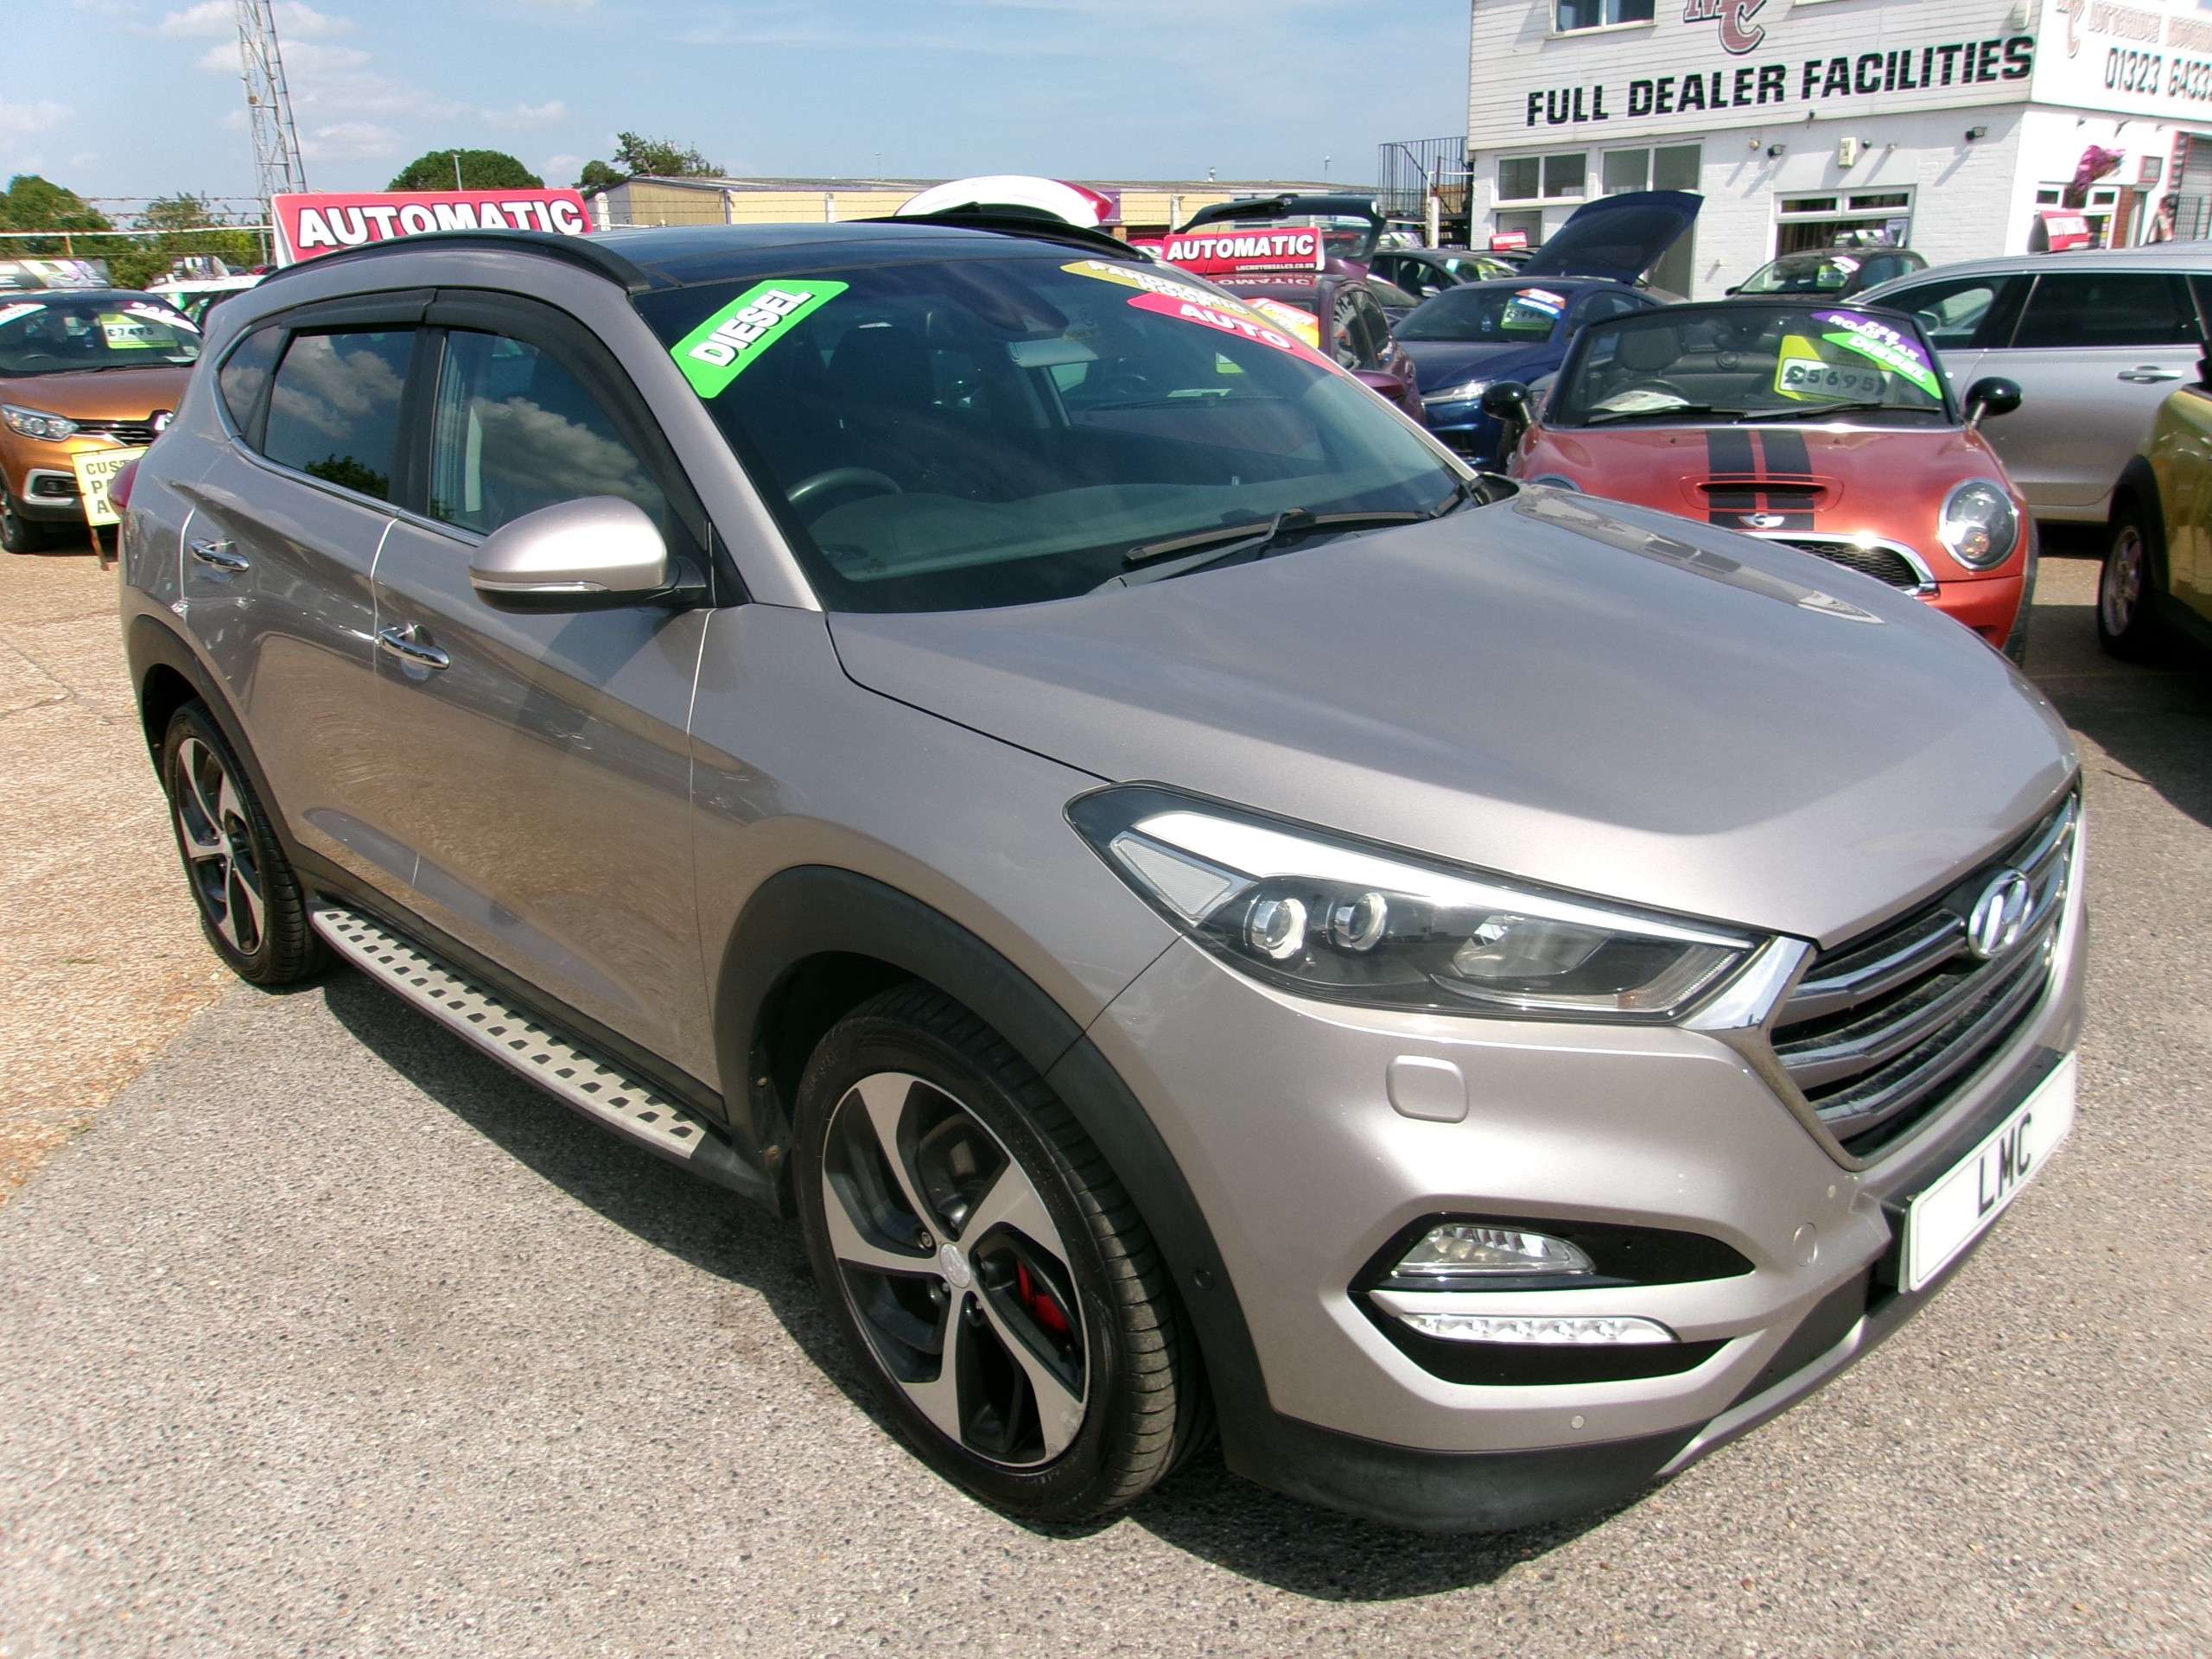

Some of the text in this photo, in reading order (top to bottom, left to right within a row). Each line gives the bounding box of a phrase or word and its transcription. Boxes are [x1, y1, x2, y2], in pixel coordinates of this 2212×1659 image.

[1527, 36, 2035, 127] FULL DEALER FACILITIES
[2105, 48, 2162, 95] 01323
[297, 199, 584, 250] AUTOMATIC
[1166, 234, 1315, 261] AUTOMATIC
[687, 289, 817, 367] DIESEL
[1180, 303, 1293, 349] AUTO
[1847, 334, 1926, 383] DIESEL
[1978, 1112, 2032, 1218] LMC
